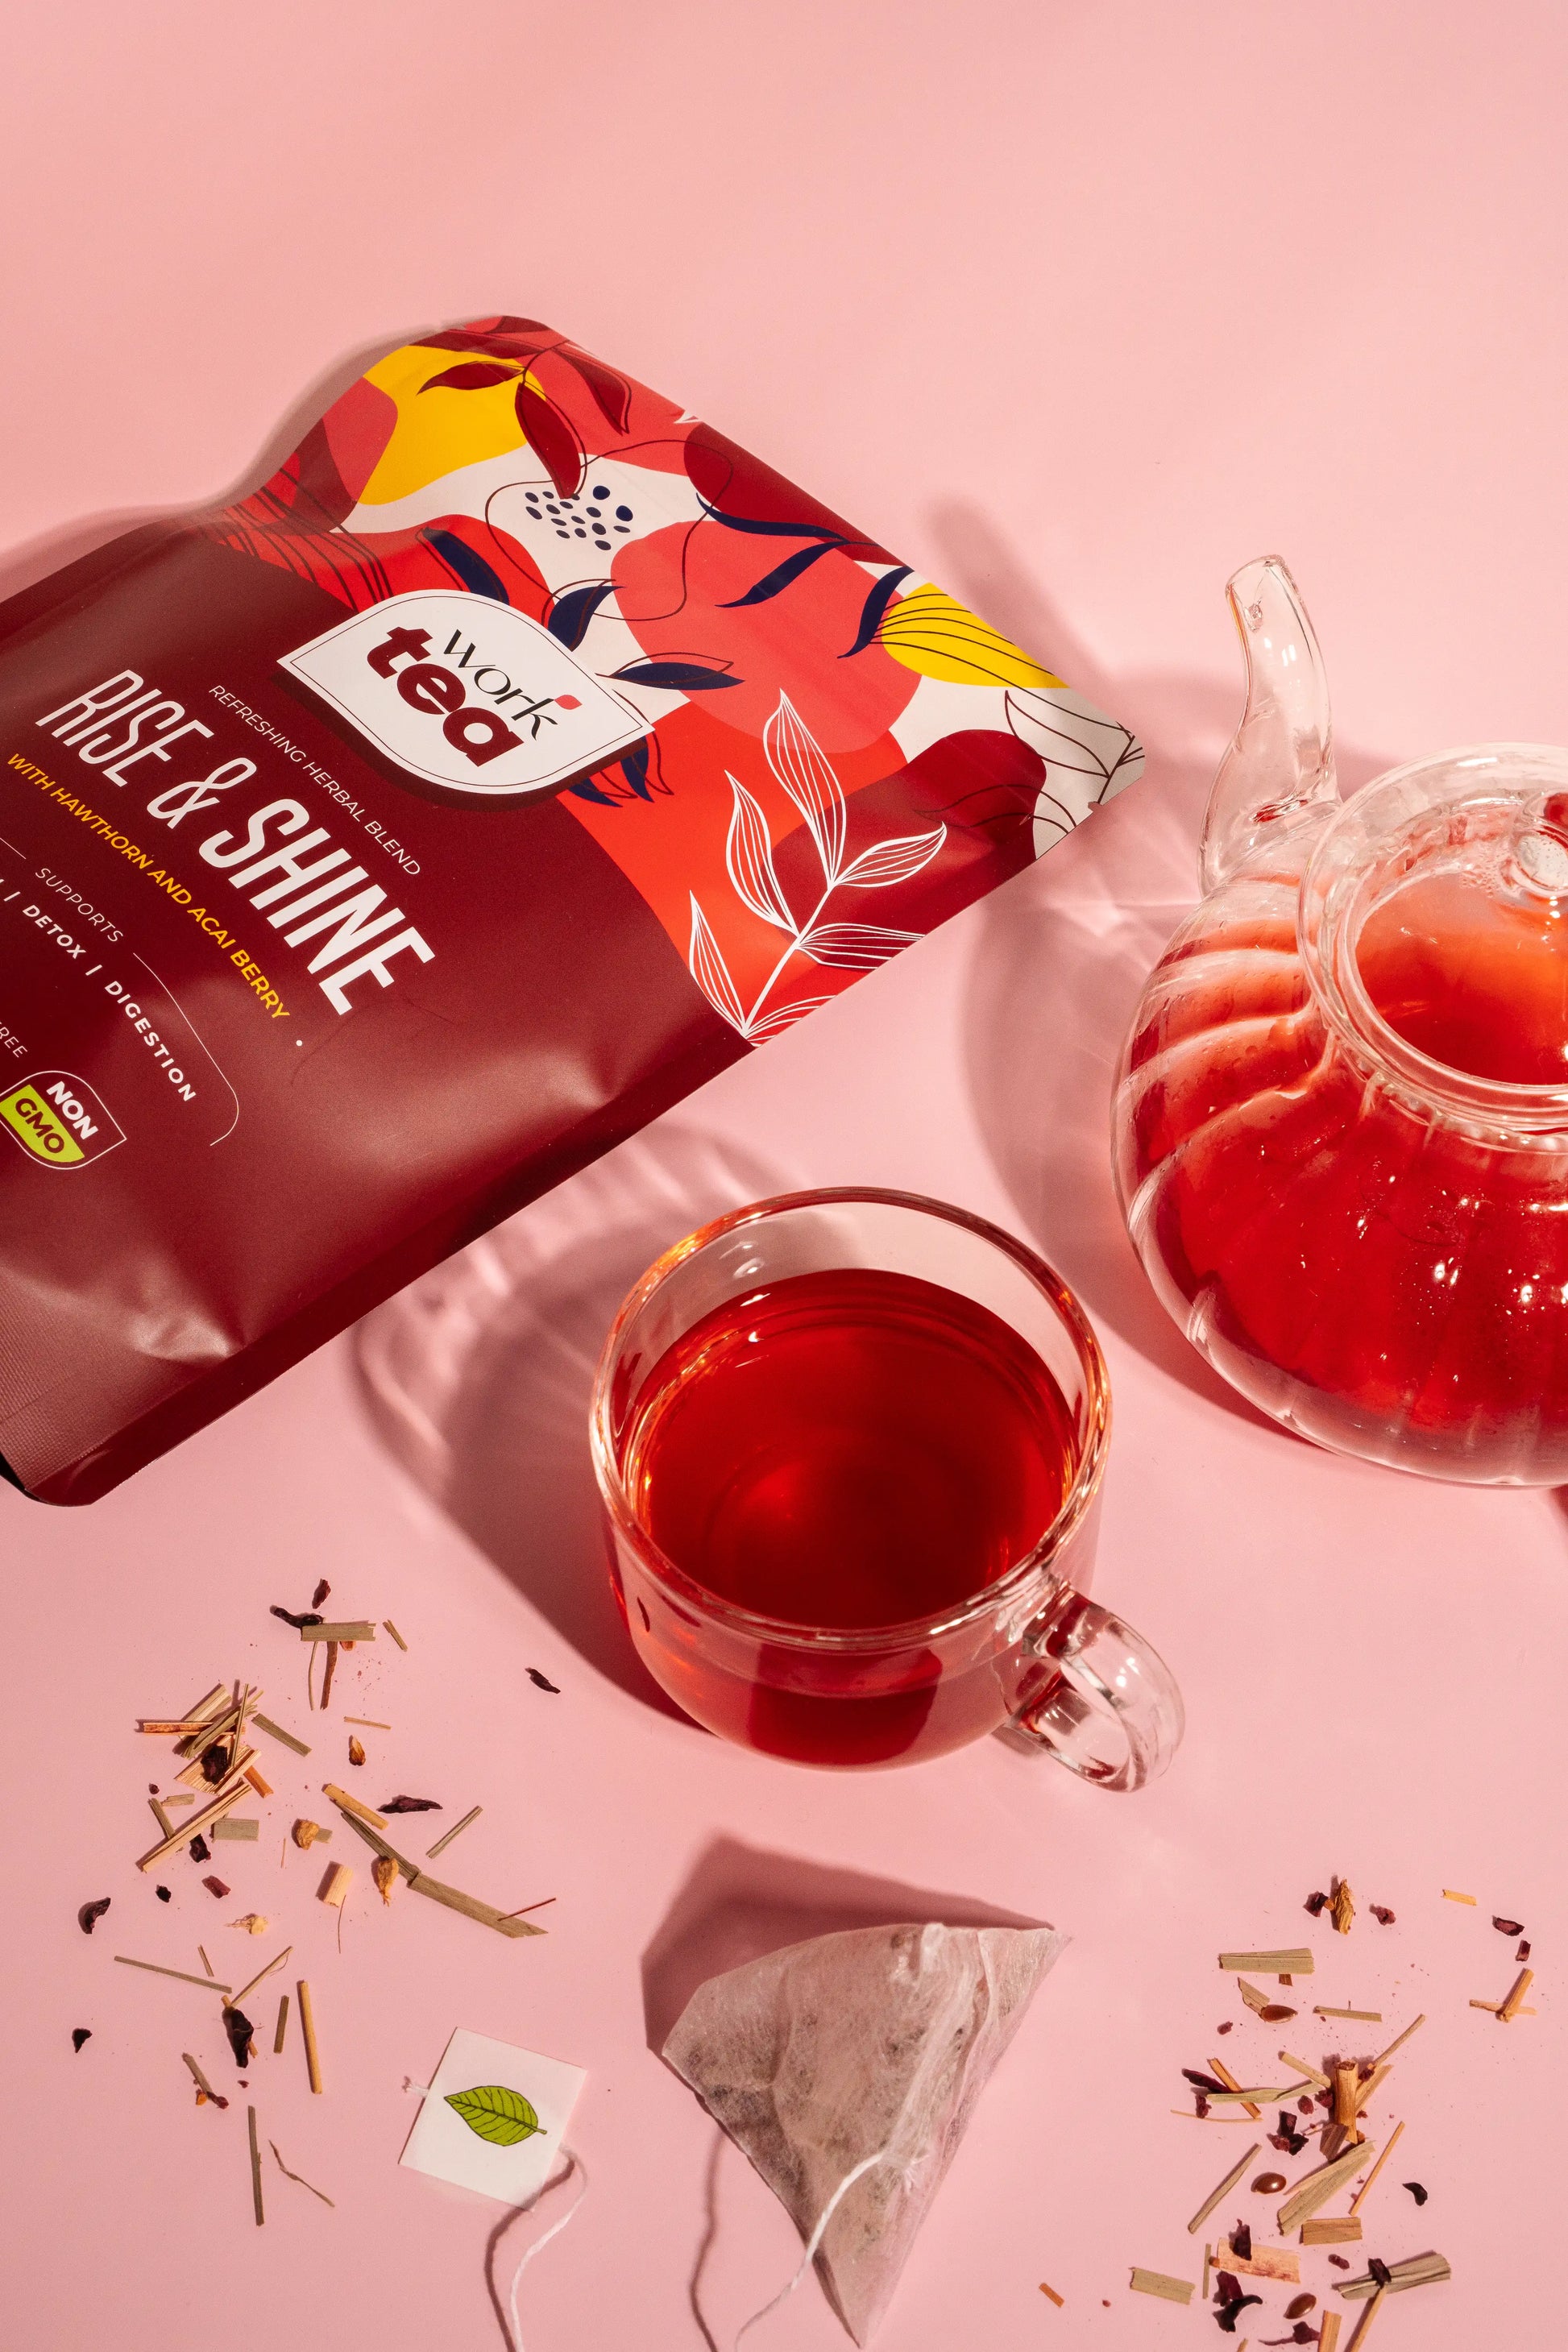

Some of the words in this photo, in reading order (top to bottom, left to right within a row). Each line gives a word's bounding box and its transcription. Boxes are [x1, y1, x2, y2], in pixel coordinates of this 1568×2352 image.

[35, 669, 214, 787] RISE
[367, 626, 525, 767] tea
[444, 628, 558, 740] work
[147, 757, 257, 830] &
[208, 685, 307, 762] REFRESHING
[302, 761, 365, 823] HERBAL
[363, 820, 421, 875] BLEND
[7, 753, 56, 790] WITH
[50, 787, 154, 869] HAWTHORN
[147, 869, 192, 904] AND
[187, 907, 236, 949] ACAI
[230, 949, 291, 1018] BERRY
[35, 868, 123, 942] SUPPORTS
[198, 799, 436, 1016] SHINE
[0, 1022, 28, 1058] REE
[22, 904, 86, 959] DETOX
[104, 981, 197, 1101] DIGESTION
[15, 1097, 65, 1154] GMO
[46, 1081, 99, 1140] NON
